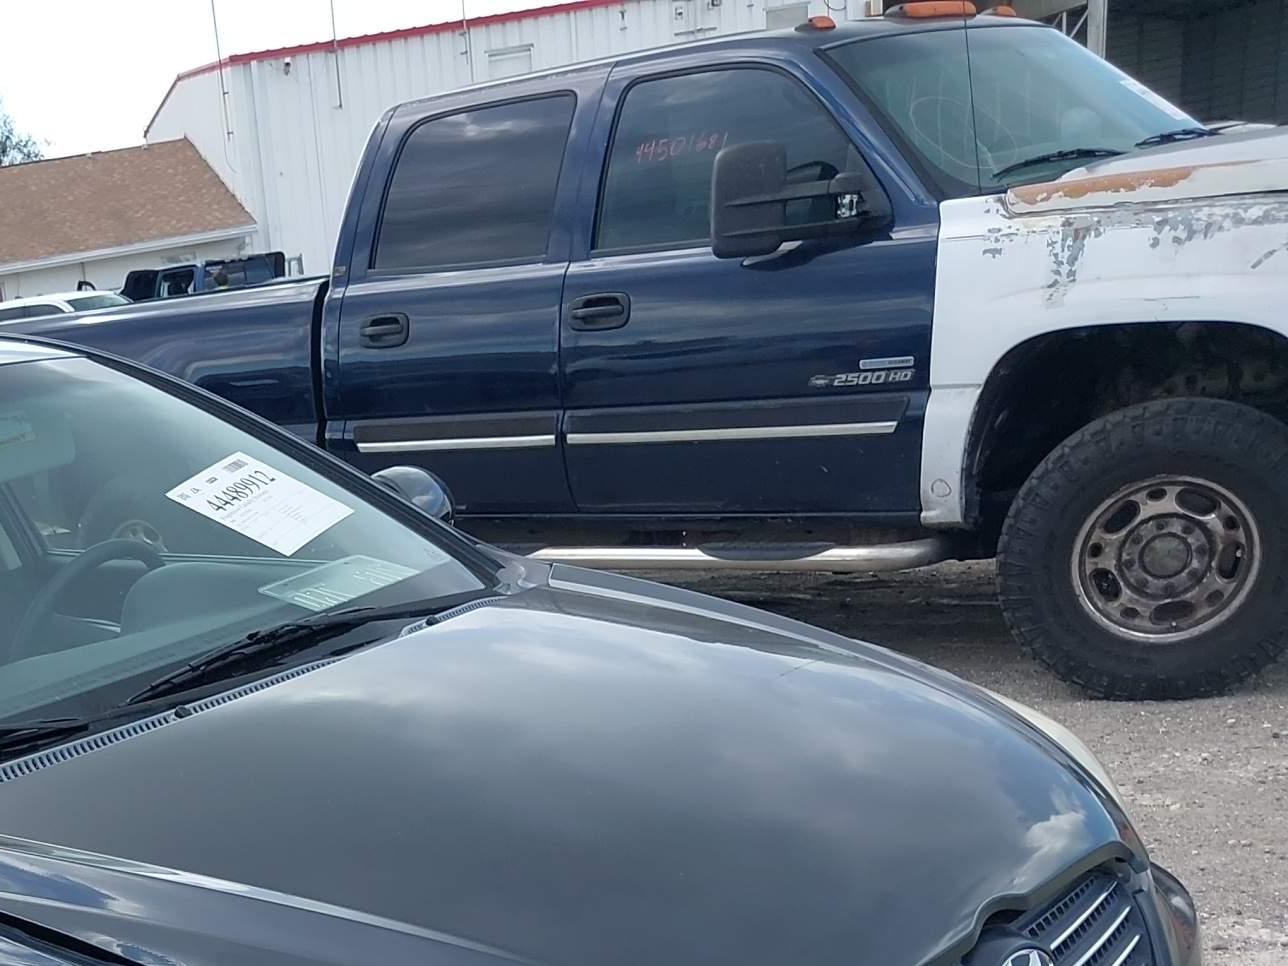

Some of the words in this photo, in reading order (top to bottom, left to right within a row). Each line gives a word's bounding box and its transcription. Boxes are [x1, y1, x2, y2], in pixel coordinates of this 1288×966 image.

[832, 371, 887, 386] 2500
[888, 369, 914, 382] HD
[206, 470, 276, 511] 44489912
